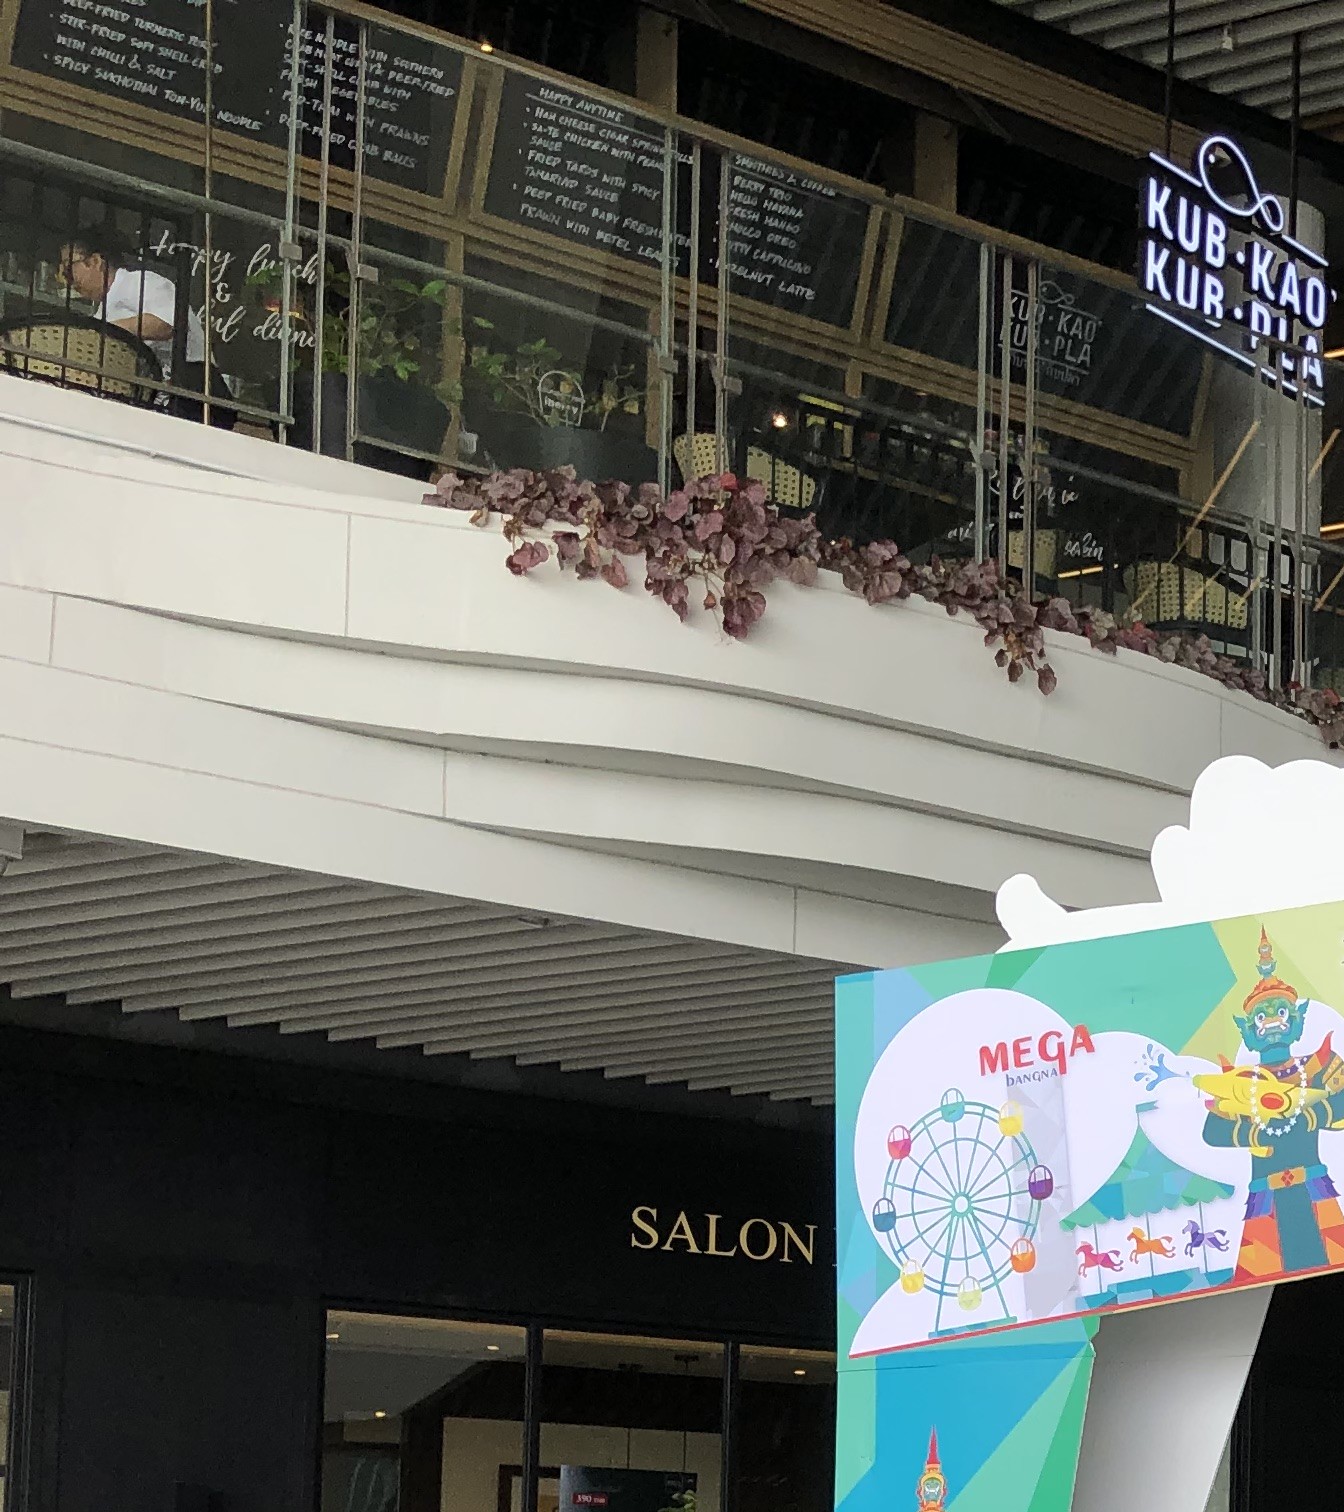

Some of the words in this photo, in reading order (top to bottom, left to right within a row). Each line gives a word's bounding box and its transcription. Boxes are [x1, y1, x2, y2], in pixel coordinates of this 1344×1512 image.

[146, 63, 176, 81] SALT
[192, 57, 223, 74] CRB
[164, 89, 215, 113] TOM-YU
[539, 87, 574, 107] HAPPY
[576, 100, 624, 123] ANYTIME
[534, 106, 557, 122] HAM
[558, 116, 596, 135] CHEESE
[529, 135, 563, 152] SAUCE
[564, 133, 610, 152] CHICKEN
[527, 150, 562, 168] FRIED
[601, 174, 626, 190] WITH
[523, 185, 553, 201] DEEP
[555, 195, 588, 213] FRIED
[778, 281, 816, 300] LATTE
[979, 1024, 1096, 1077] MEGA
[631, 1205, 819, 1265] SALON
